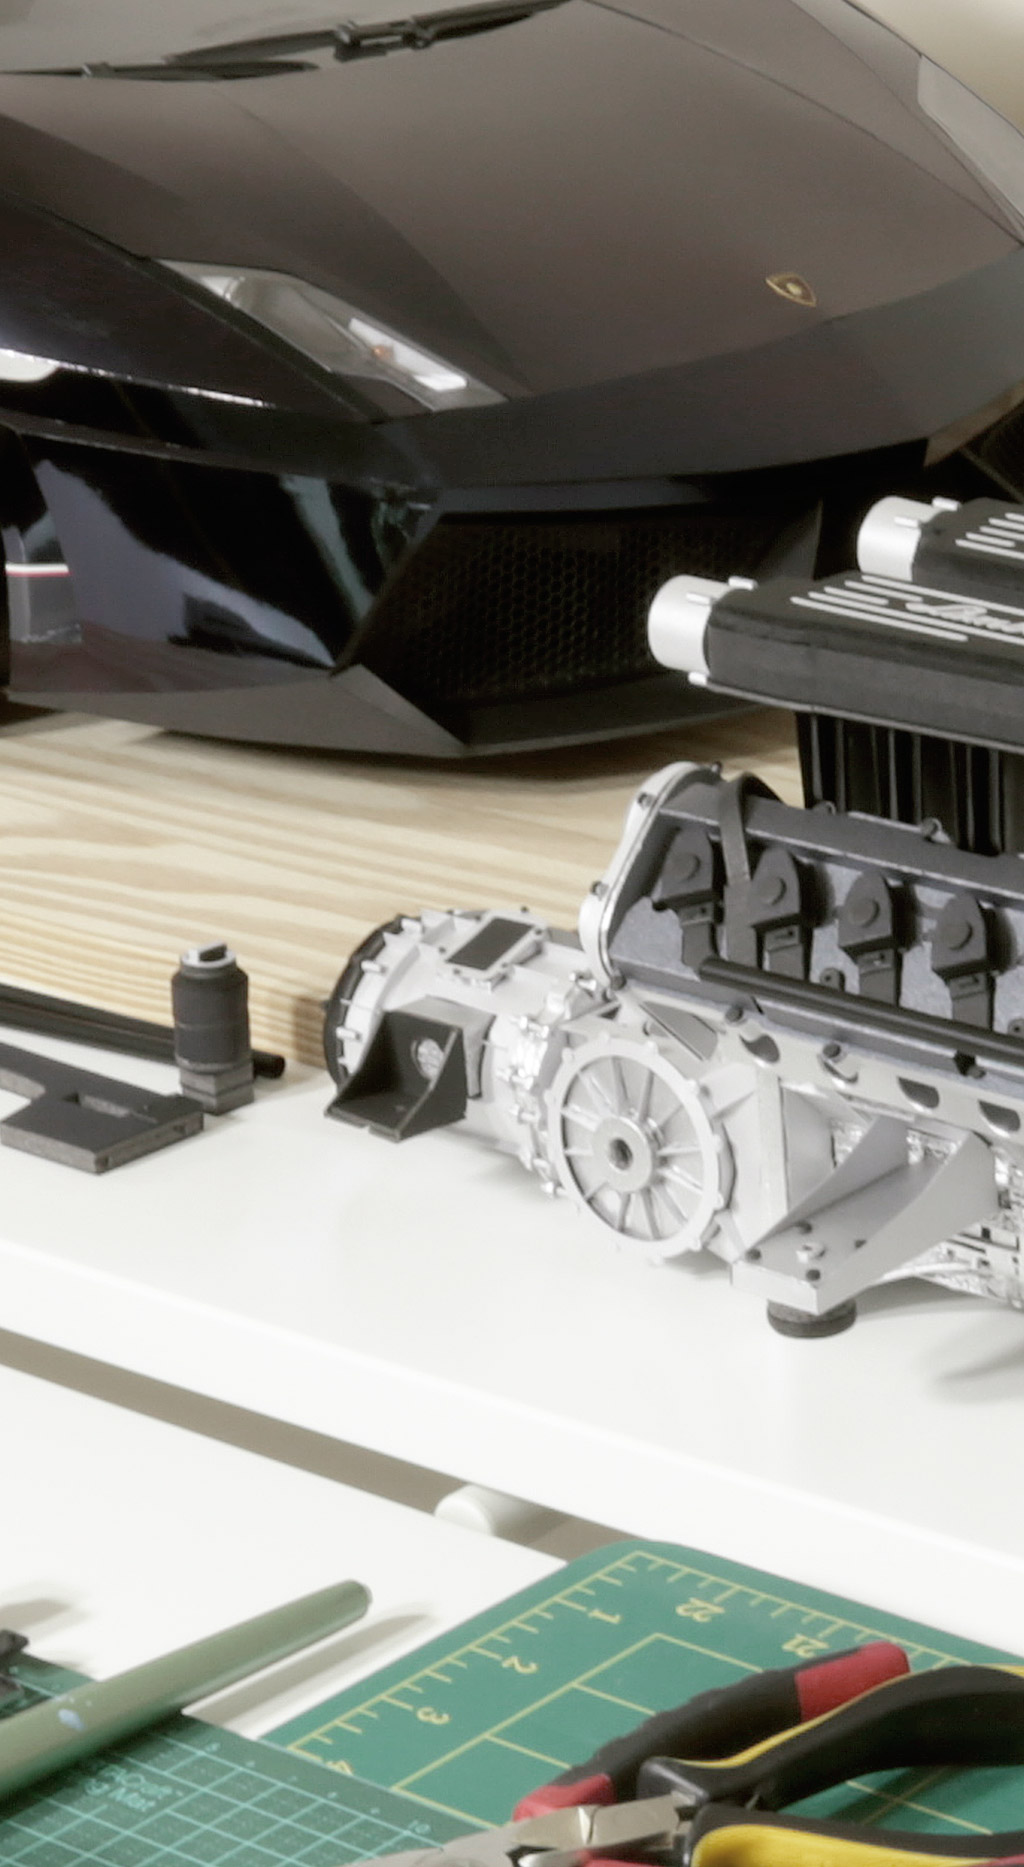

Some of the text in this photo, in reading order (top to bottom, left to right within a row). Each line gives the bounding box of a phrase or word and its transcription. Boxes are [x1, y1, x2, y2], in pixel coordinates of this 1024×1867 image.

[588, 1609, 621, 1624] 1
[675, 1597, 725, 1622] 22
[781, 1633, 830, 1658] 21
[502, 1655, 538, 1674] 2
[416, 1706, 449, 1725] 3
